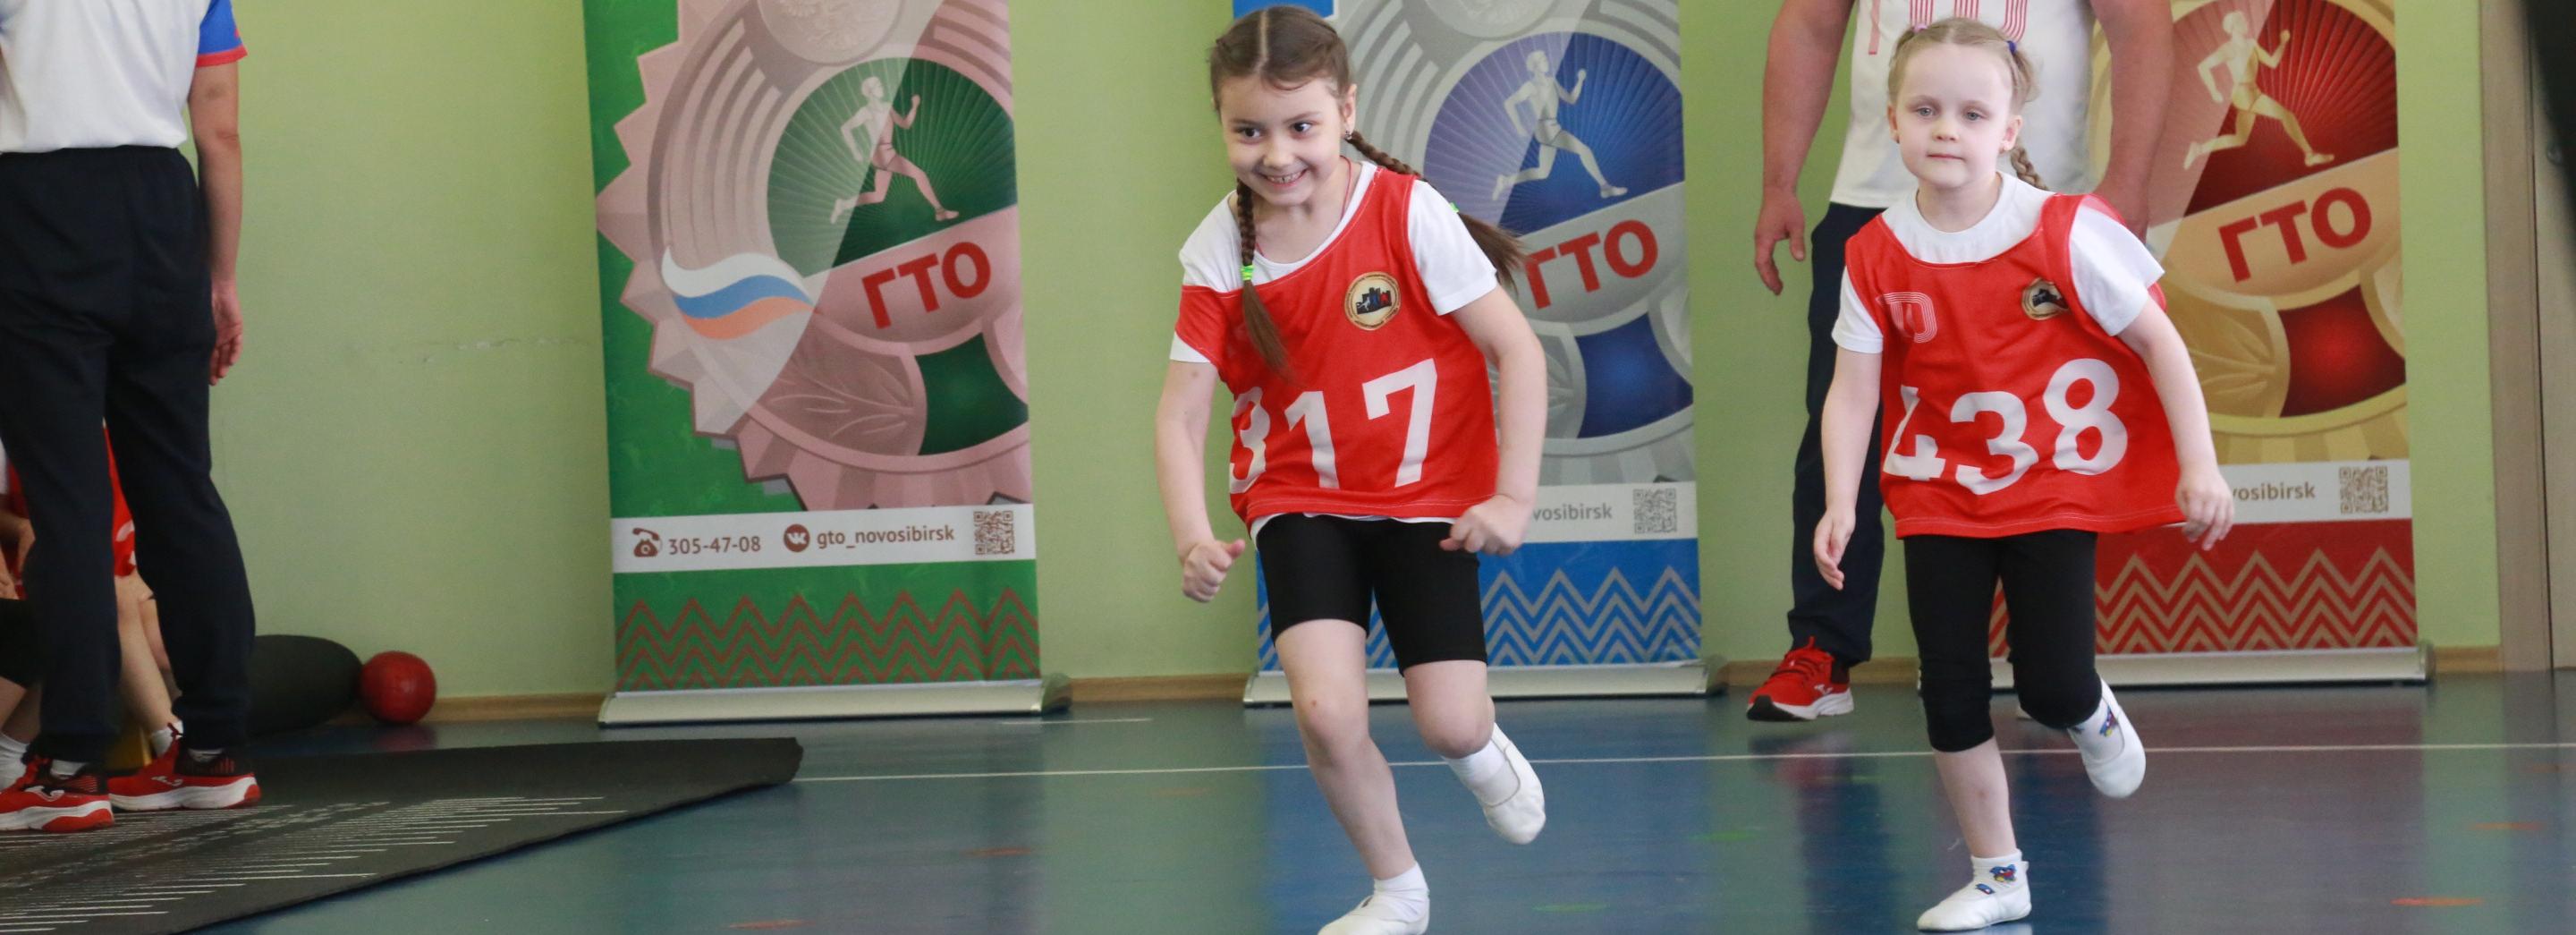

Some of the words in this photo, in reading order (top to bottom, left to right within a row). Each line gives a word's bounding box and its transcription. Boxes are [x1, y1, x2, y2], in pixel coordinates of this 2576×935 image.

[1524, 219, 1658, 310] ГТО
[2217, 186, 2372, 283] ГТО
[861, 241, 991, 329] ГТО
[1229, 358, 1438, 494] 317
[1883, 358, 2129, 496] 438
[668, 535, 761, 556] 305-47-08
[817, 524, 955, 549] gto_novosibirsk
